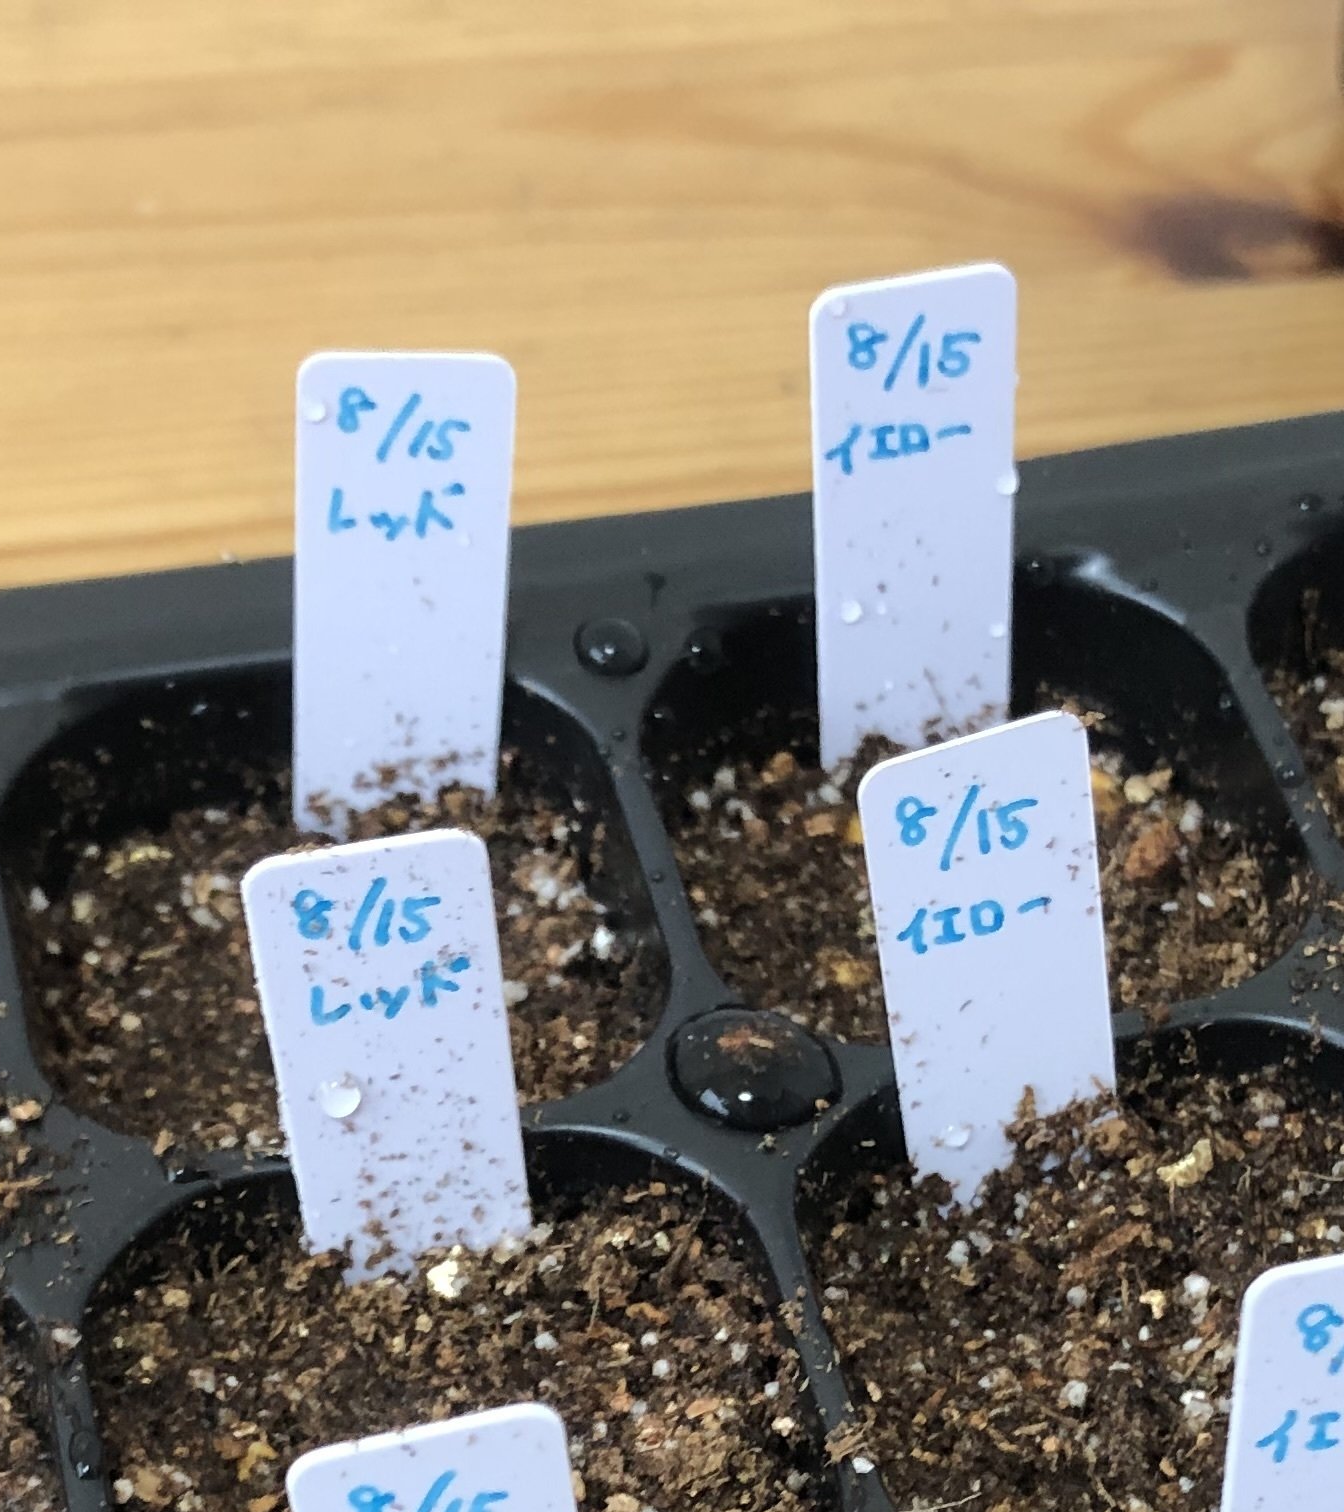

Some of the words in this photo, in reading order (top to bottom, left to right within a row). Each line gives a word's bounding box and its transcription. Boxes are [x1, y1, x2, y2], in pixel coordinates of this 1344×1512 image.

[845, 313, 982, 392] 8/15
[336, 385, 471, 463] 8/15
[894, 784, 1039, 872] 8/15
[291, 876, 442, 953] 8/15
